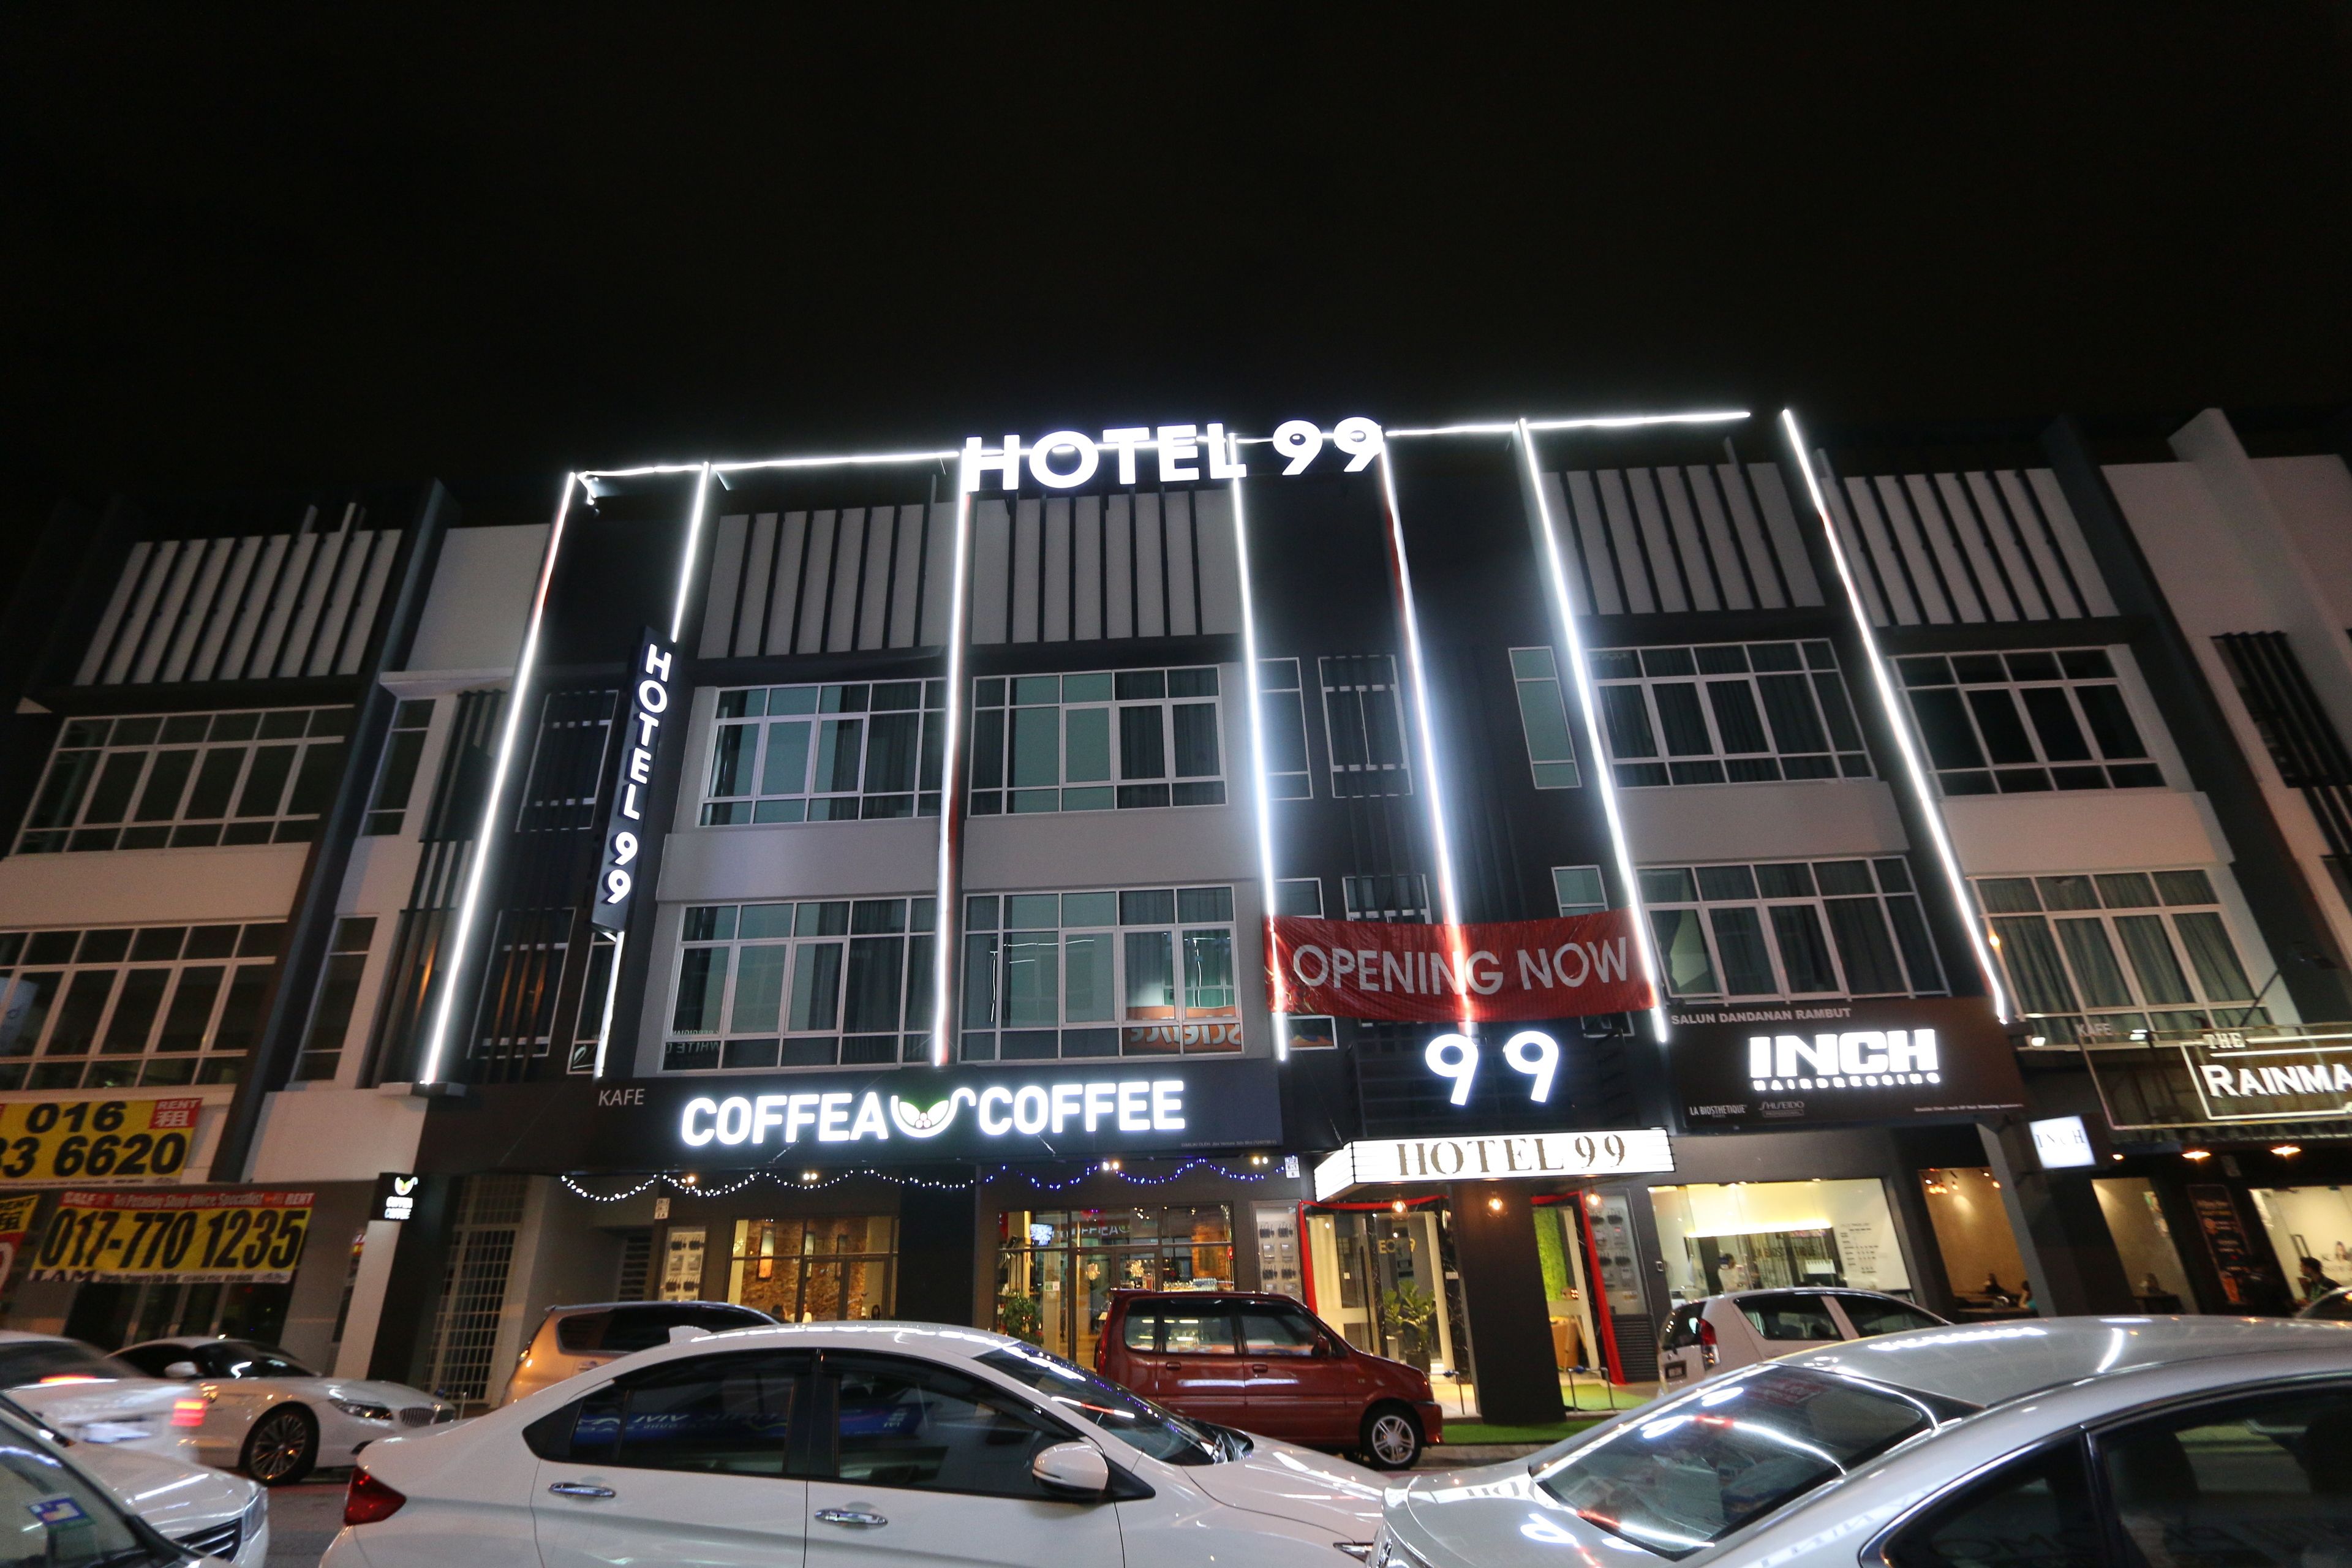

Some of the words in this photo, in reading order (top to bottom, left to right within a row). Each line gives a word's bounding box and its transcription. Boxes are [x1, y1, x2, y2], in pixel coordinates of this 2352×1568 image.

[962, 423, 1247, 492] HOTEL
[1272, 417, 1383, 476] 99
[623, 643, 673, 821] HOTEL
[608, 831, 639, 905] 99
[1293, 944, 1504, 995] OPENING
[1517, 937, 1628, 990] NOW
[1671, 1012, 1716, 1025] SALUN
[1719, 1009, 1792, 1024] DANDANAN
[1796, 1008, 1852, 1020] RAMBUT
[1749, 1028, 1939, 1078] INCH
[2202, 1032, 2246, 1049] THE
[26, 1101, 127, 1133] 016
[598, 1088, 646, 1107] KAFE
[680, 1091, 889, 1147] COFFEA
[979, 1080, 1186, 1136] COFFEE
[1689, 1106, 1699, 1116] LA
[53, 1132, 187, 1177] 6620
[1396, 1137, 1564, 1177] HOTEL
[1574, 1134, 1627, 1168] 99
[40, 1208, 198, 1269] 017-770
[200, 1208, 307, 1269] 1235
